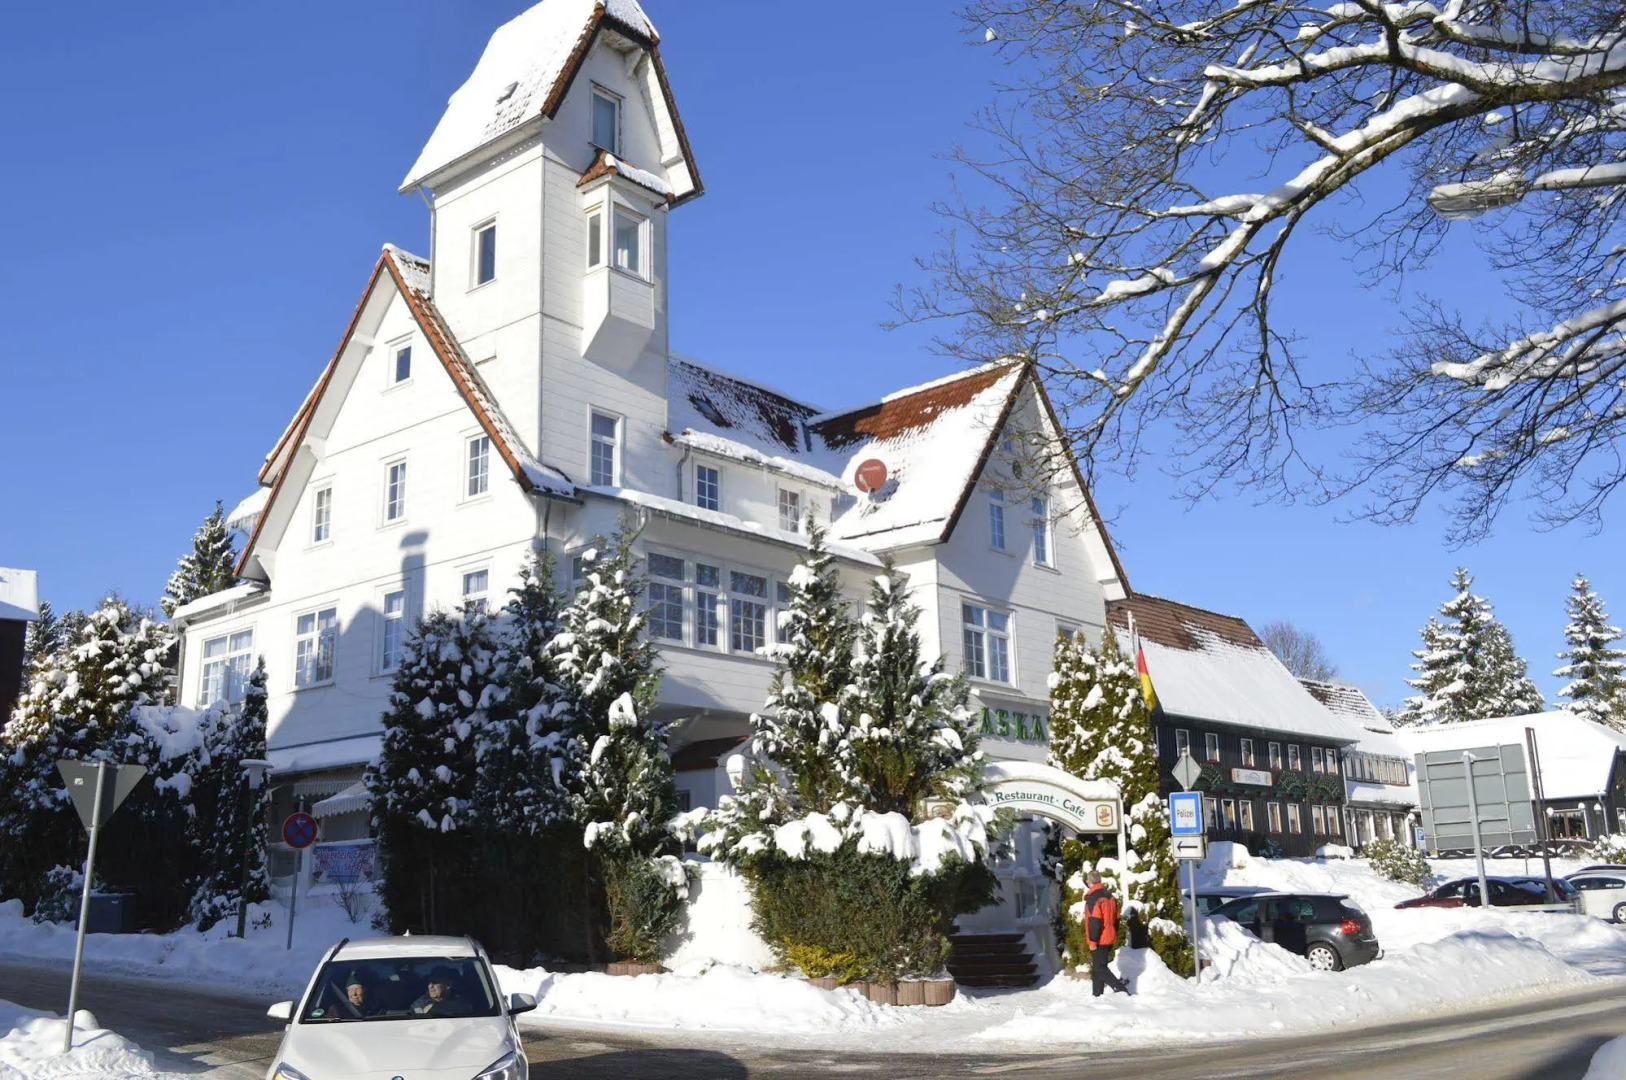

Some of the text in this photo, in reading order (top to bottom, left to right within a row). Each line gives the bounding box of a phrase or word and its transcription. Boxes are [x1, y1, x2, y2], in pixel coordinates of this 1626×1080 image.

[977, 706, 1051, 742] ASKA
[995, 791, 1055, 804] Restaurant
[1062, 798, 1086, 818] Café
[1176, 808, 1194, 818] Polizei
